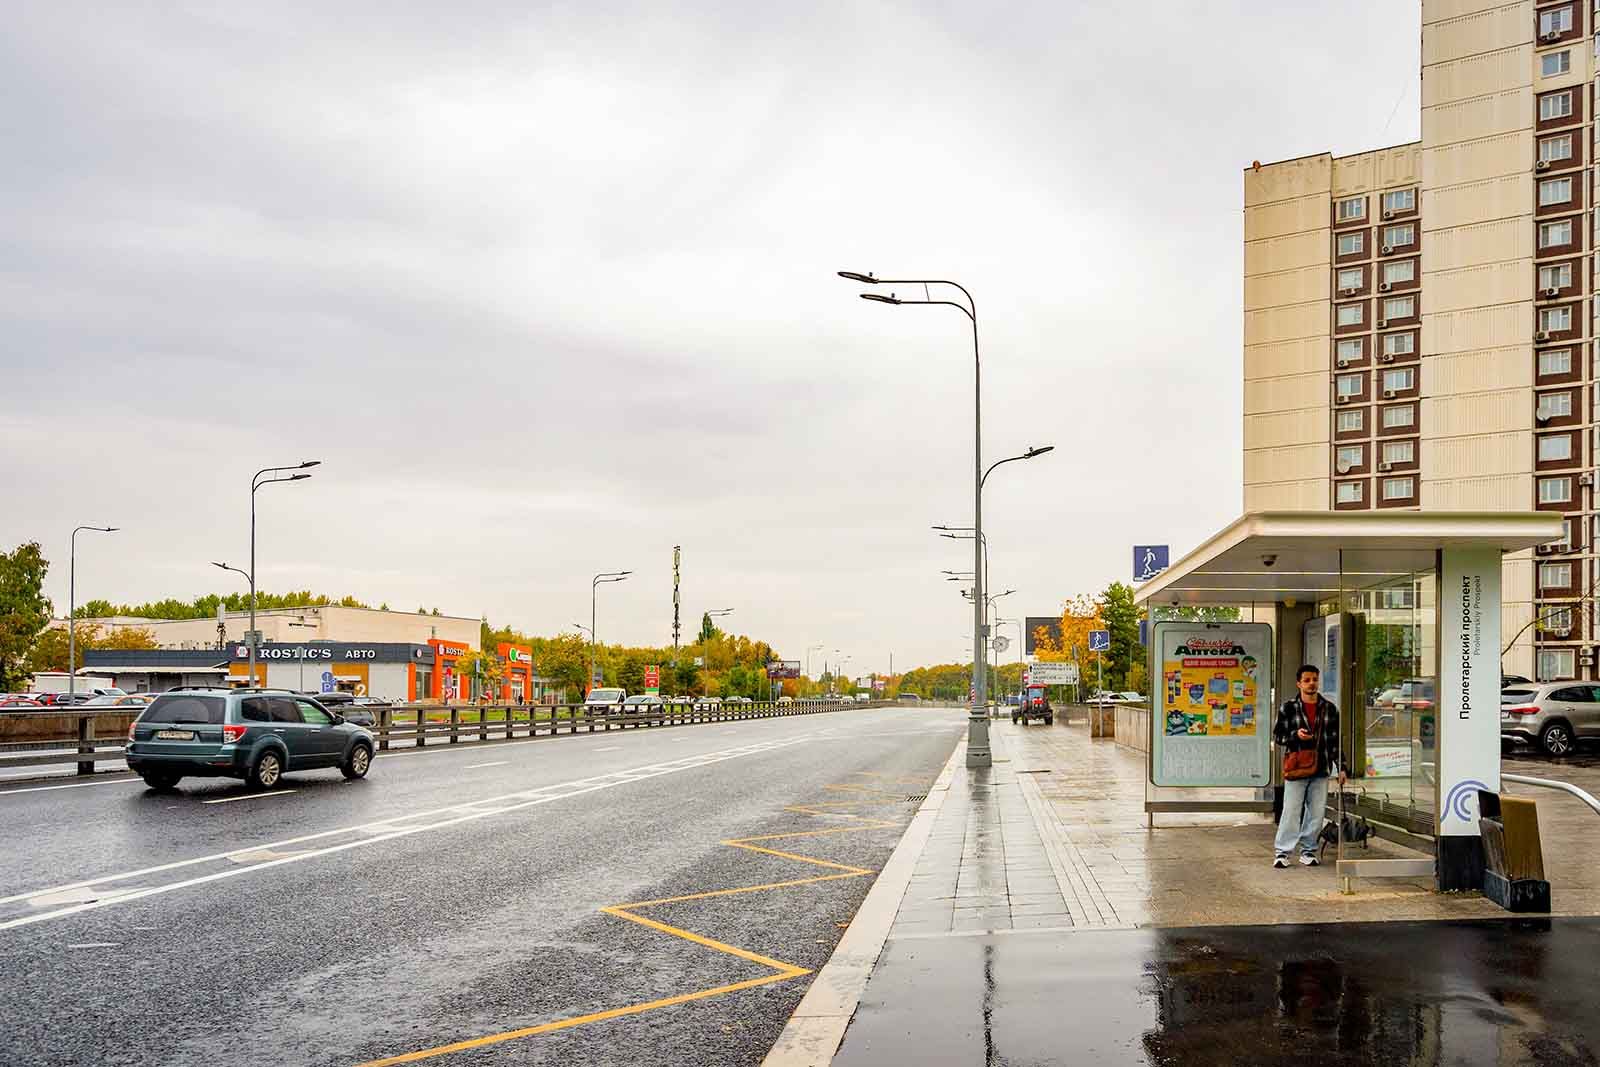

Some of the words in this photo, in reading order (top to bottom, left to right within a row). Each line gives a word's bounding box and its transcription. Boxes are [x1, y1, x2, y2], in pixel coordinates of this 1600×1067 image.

[1462, 575, 1472, 631] проспект
[1473, 575, 1482, 609] Prospekt
[1473, 611, 1483, 656] Proletarskiy
[260, 648, 332, 659] ROSTIC'S
[345, 649, 376, 659] АВТО
[356, 683, 367, 697] 2
[1459, 634, 1472, 720] Пролетарский
